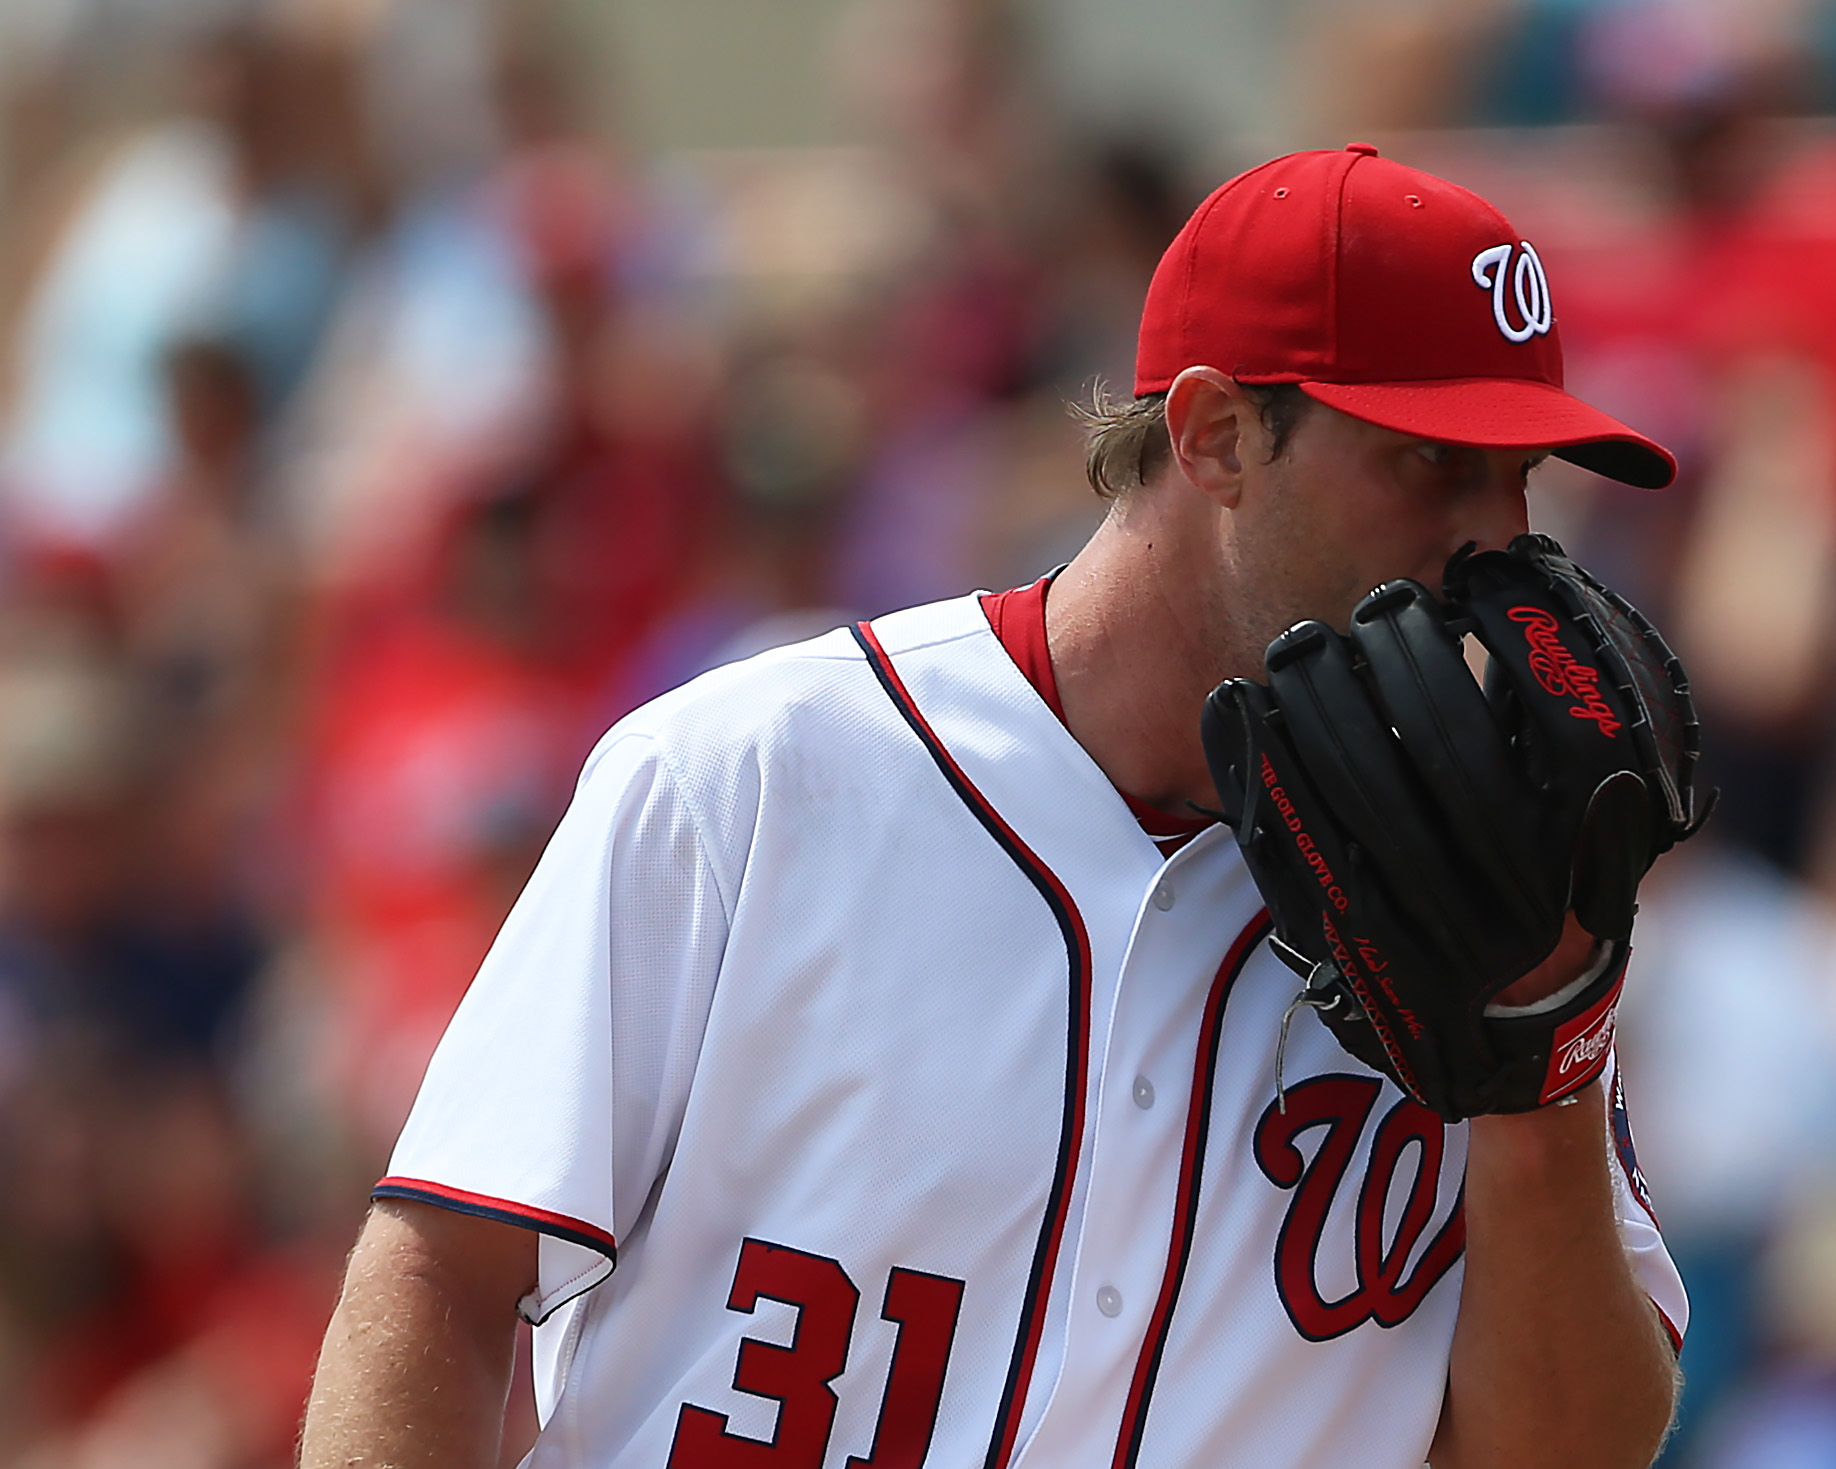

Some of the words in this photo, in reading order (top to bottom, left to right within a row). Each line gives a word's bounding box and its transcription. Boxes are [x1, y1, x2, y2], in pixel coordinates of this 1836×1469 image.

[1471, 240, 1553, 345] W
[1506, 605, 1623, 738] Rawlings
[1270, 786, 1303, 832] GOLD
[1296, 832, 1334, 887] GLOVE
[1327, 885, 1350, 914] CO.
[1253, 1072, 1467, 1343] W
